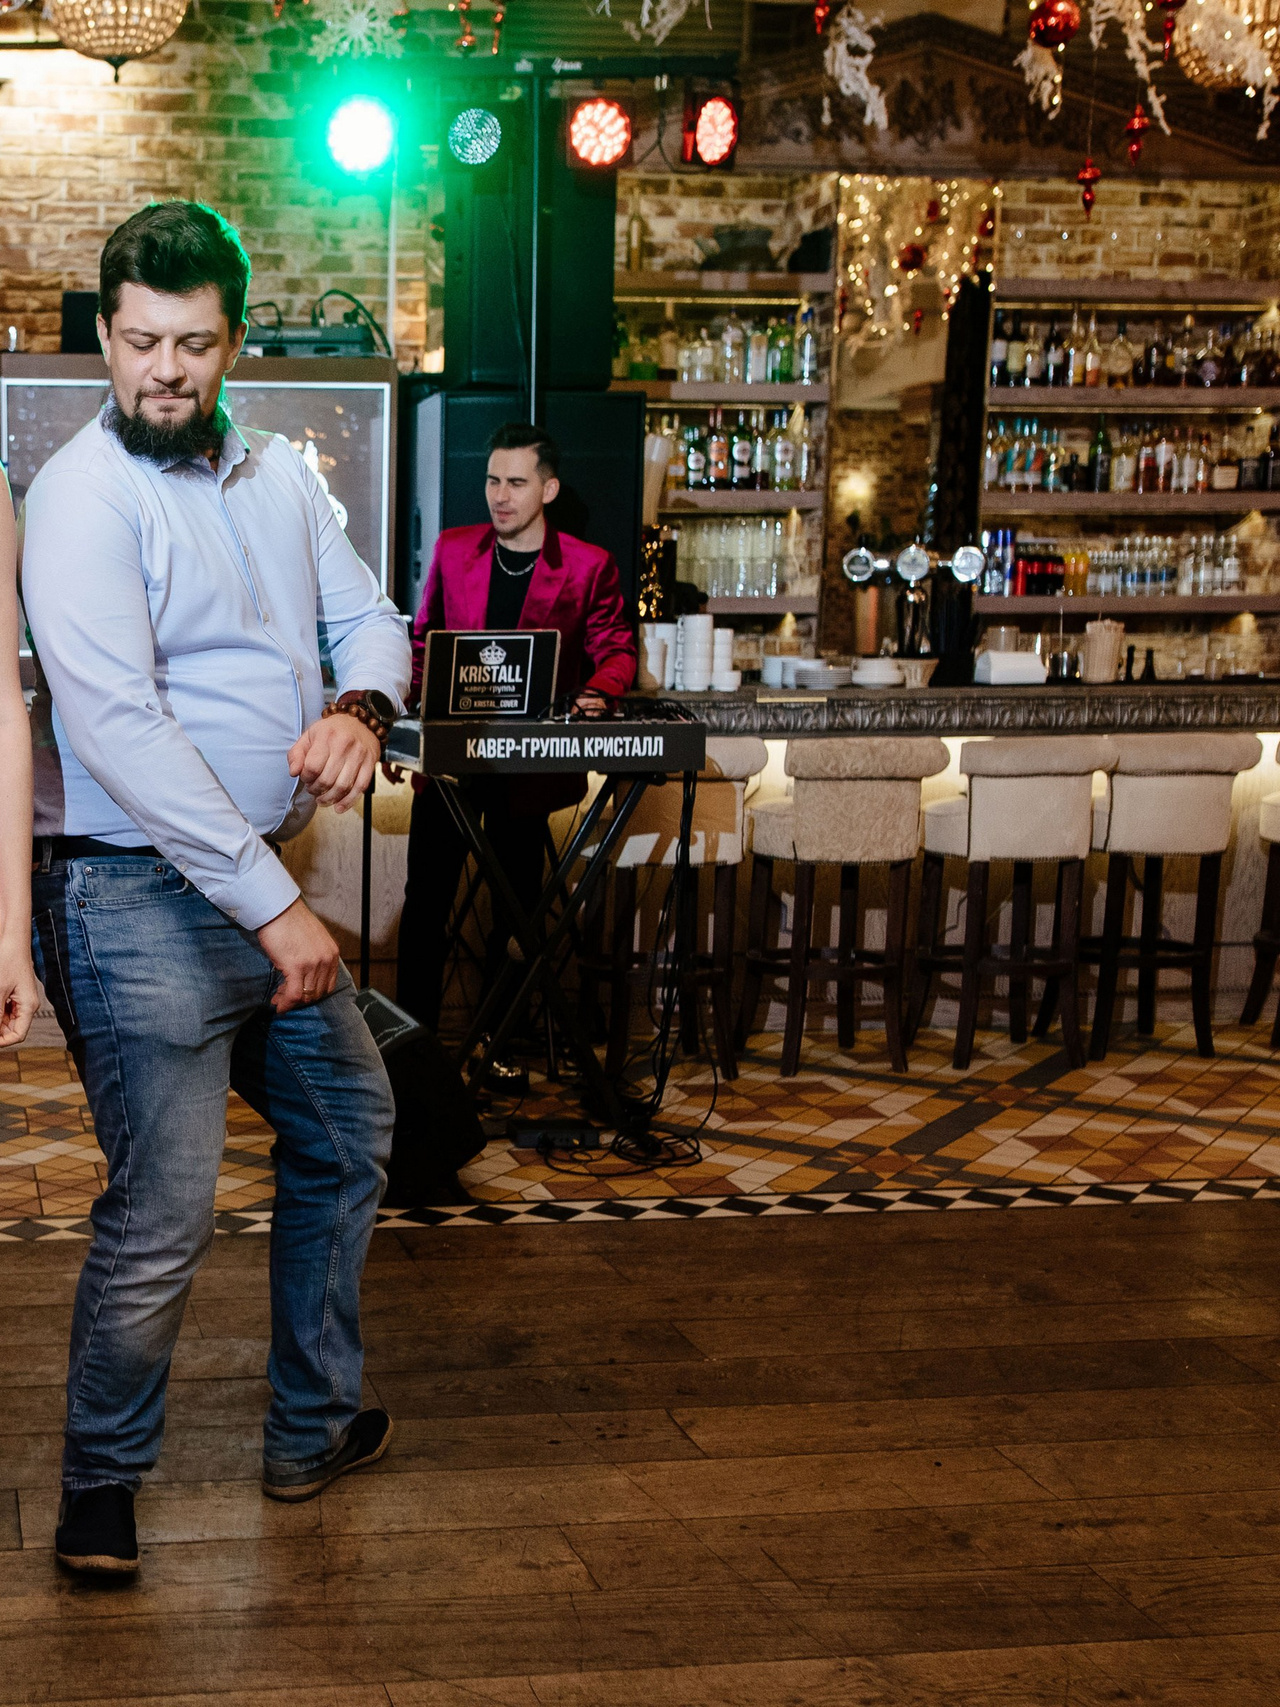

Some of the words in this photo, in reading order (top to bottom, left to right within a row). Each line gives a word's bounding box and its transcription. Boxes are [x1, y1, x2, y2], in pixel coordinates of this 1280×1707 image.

[459, 665, 523, 683] KRISTALL
[466, 737, 580, 758] КАВЕР-ГРУППА
[584, 736, 663, 757] КРИСТАЛЛ
